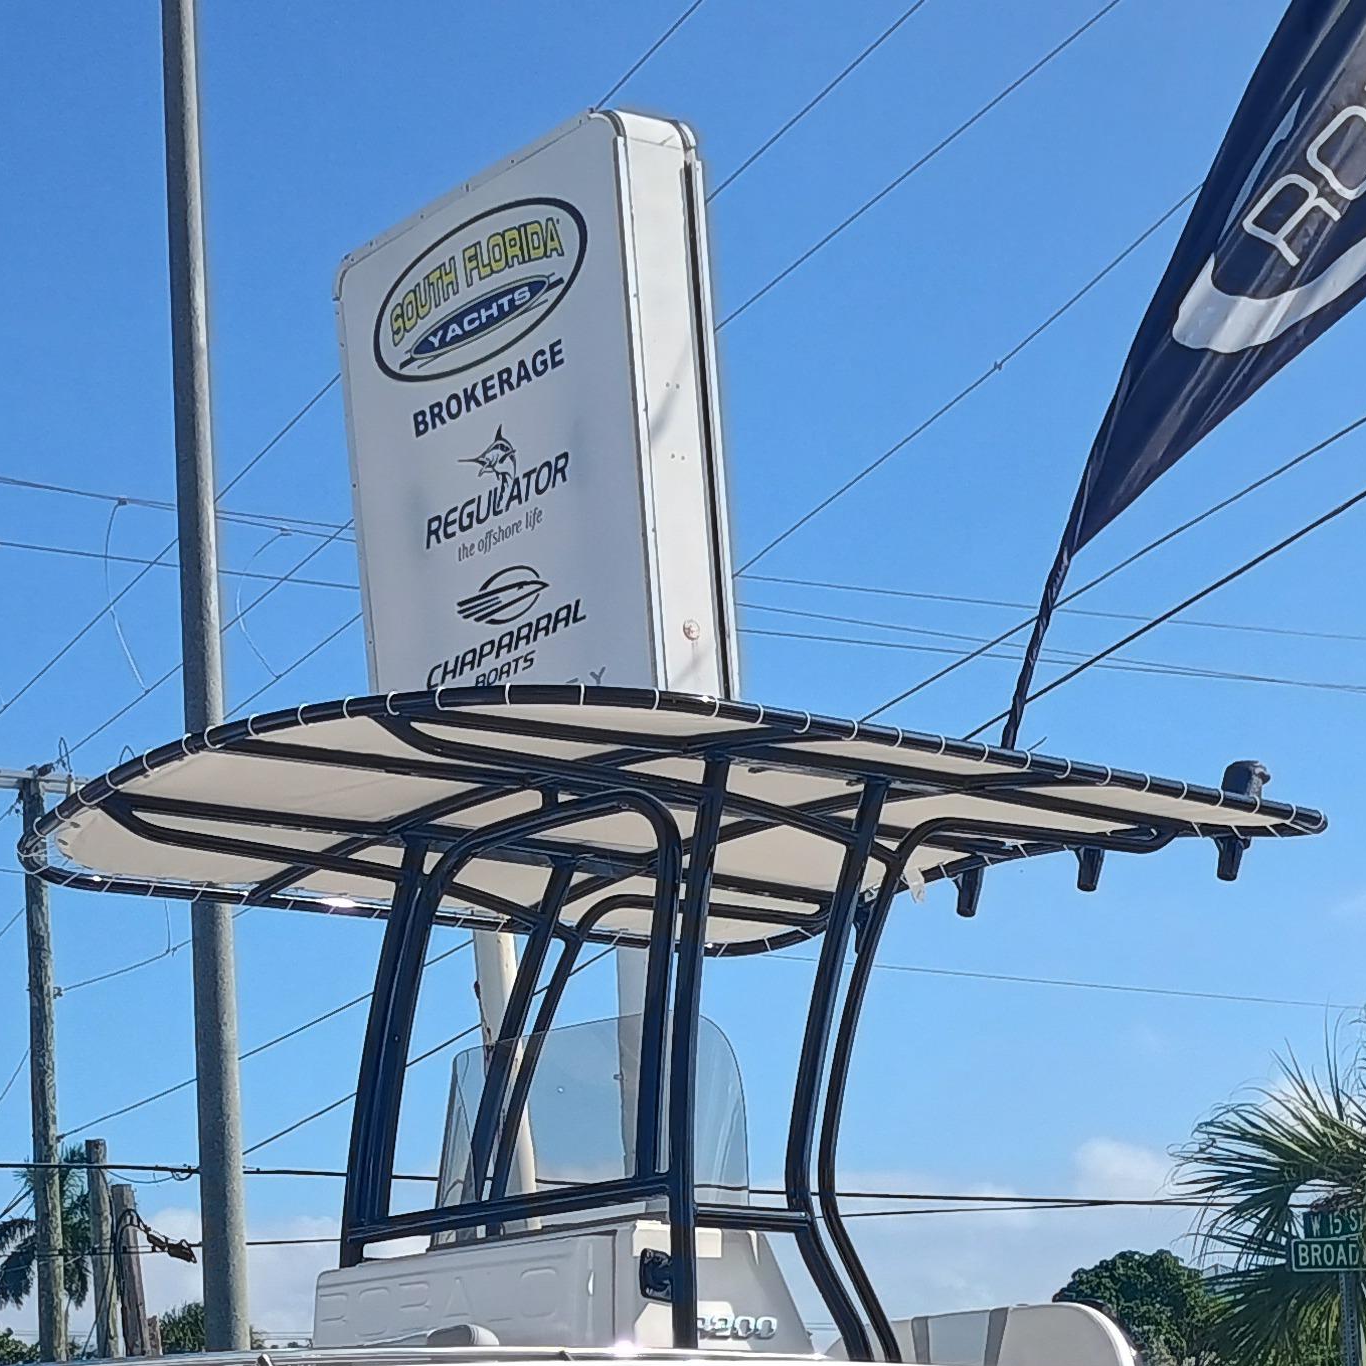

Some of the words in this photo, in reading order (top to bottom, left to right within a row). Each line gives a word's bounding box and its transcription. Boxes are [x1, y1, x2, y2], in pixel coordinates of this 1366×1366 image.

[390, 256, 459, 347] SOUTH
[463, 217, 565, 288] FLORIDA
[427, 286, 531, 348] YACHTS
[413, 339, 564, 438] BROKERAGE
[426, 451, 569, 550] REGULATOR
[458, 541, 476, 562] the
[477, 518, 522, 555] offshore
[525, 506, 543, 533] life
[426, 598, 587, 691] CHAPARRAL
[474, 650, 535, 687] BOATS
[1310, 1213, 1322, 1238] W
